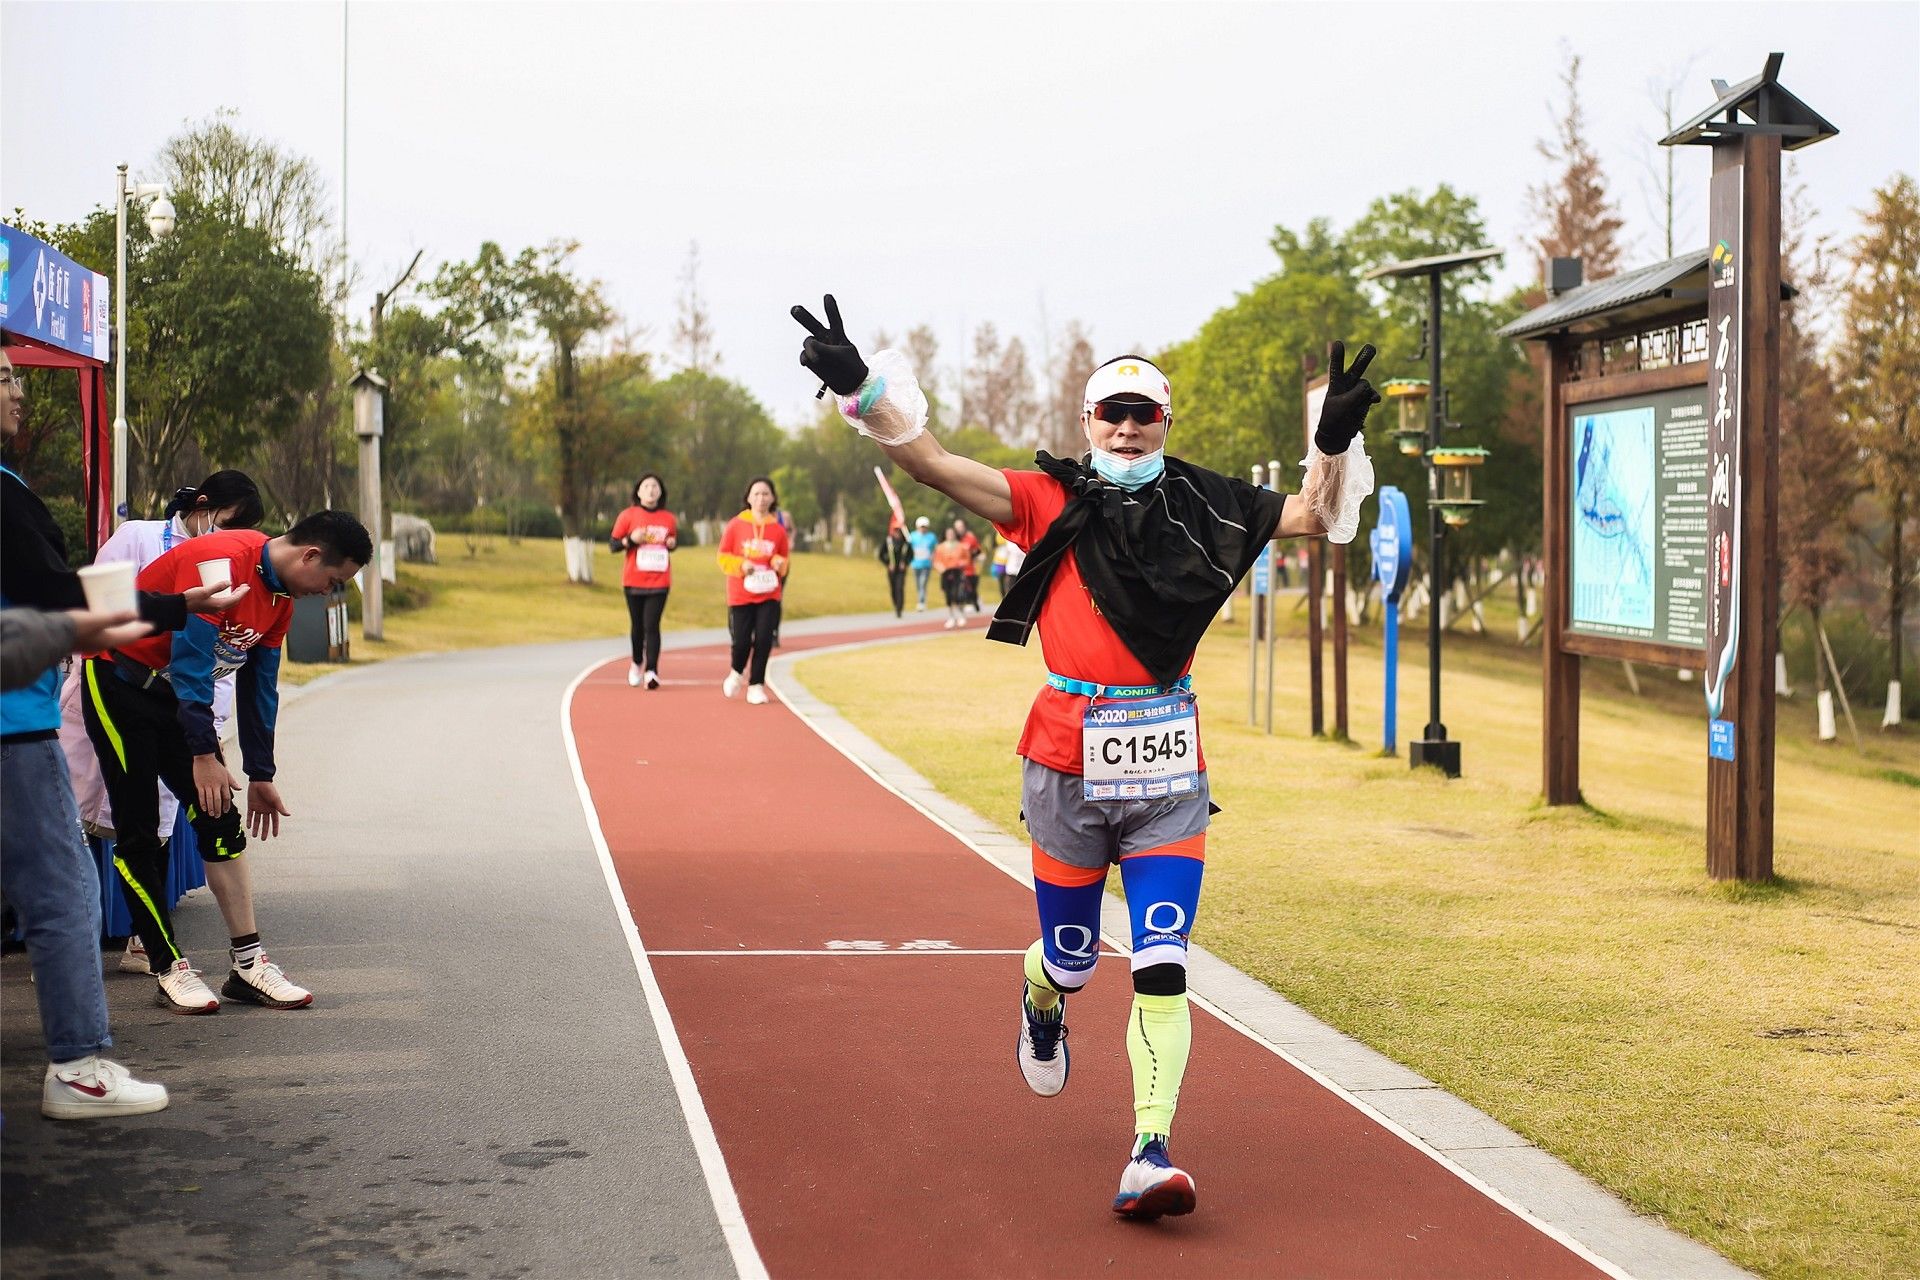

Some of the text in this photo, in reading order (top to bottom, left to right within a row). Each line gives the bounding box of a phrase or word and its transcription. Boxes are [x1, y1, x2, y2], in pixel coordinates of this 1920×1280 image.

[48, 261, 70, 309] 医疗区
[1114, 687, 1158, 696] AONIJIE
[1102, 729, 1187, 765] C1545
